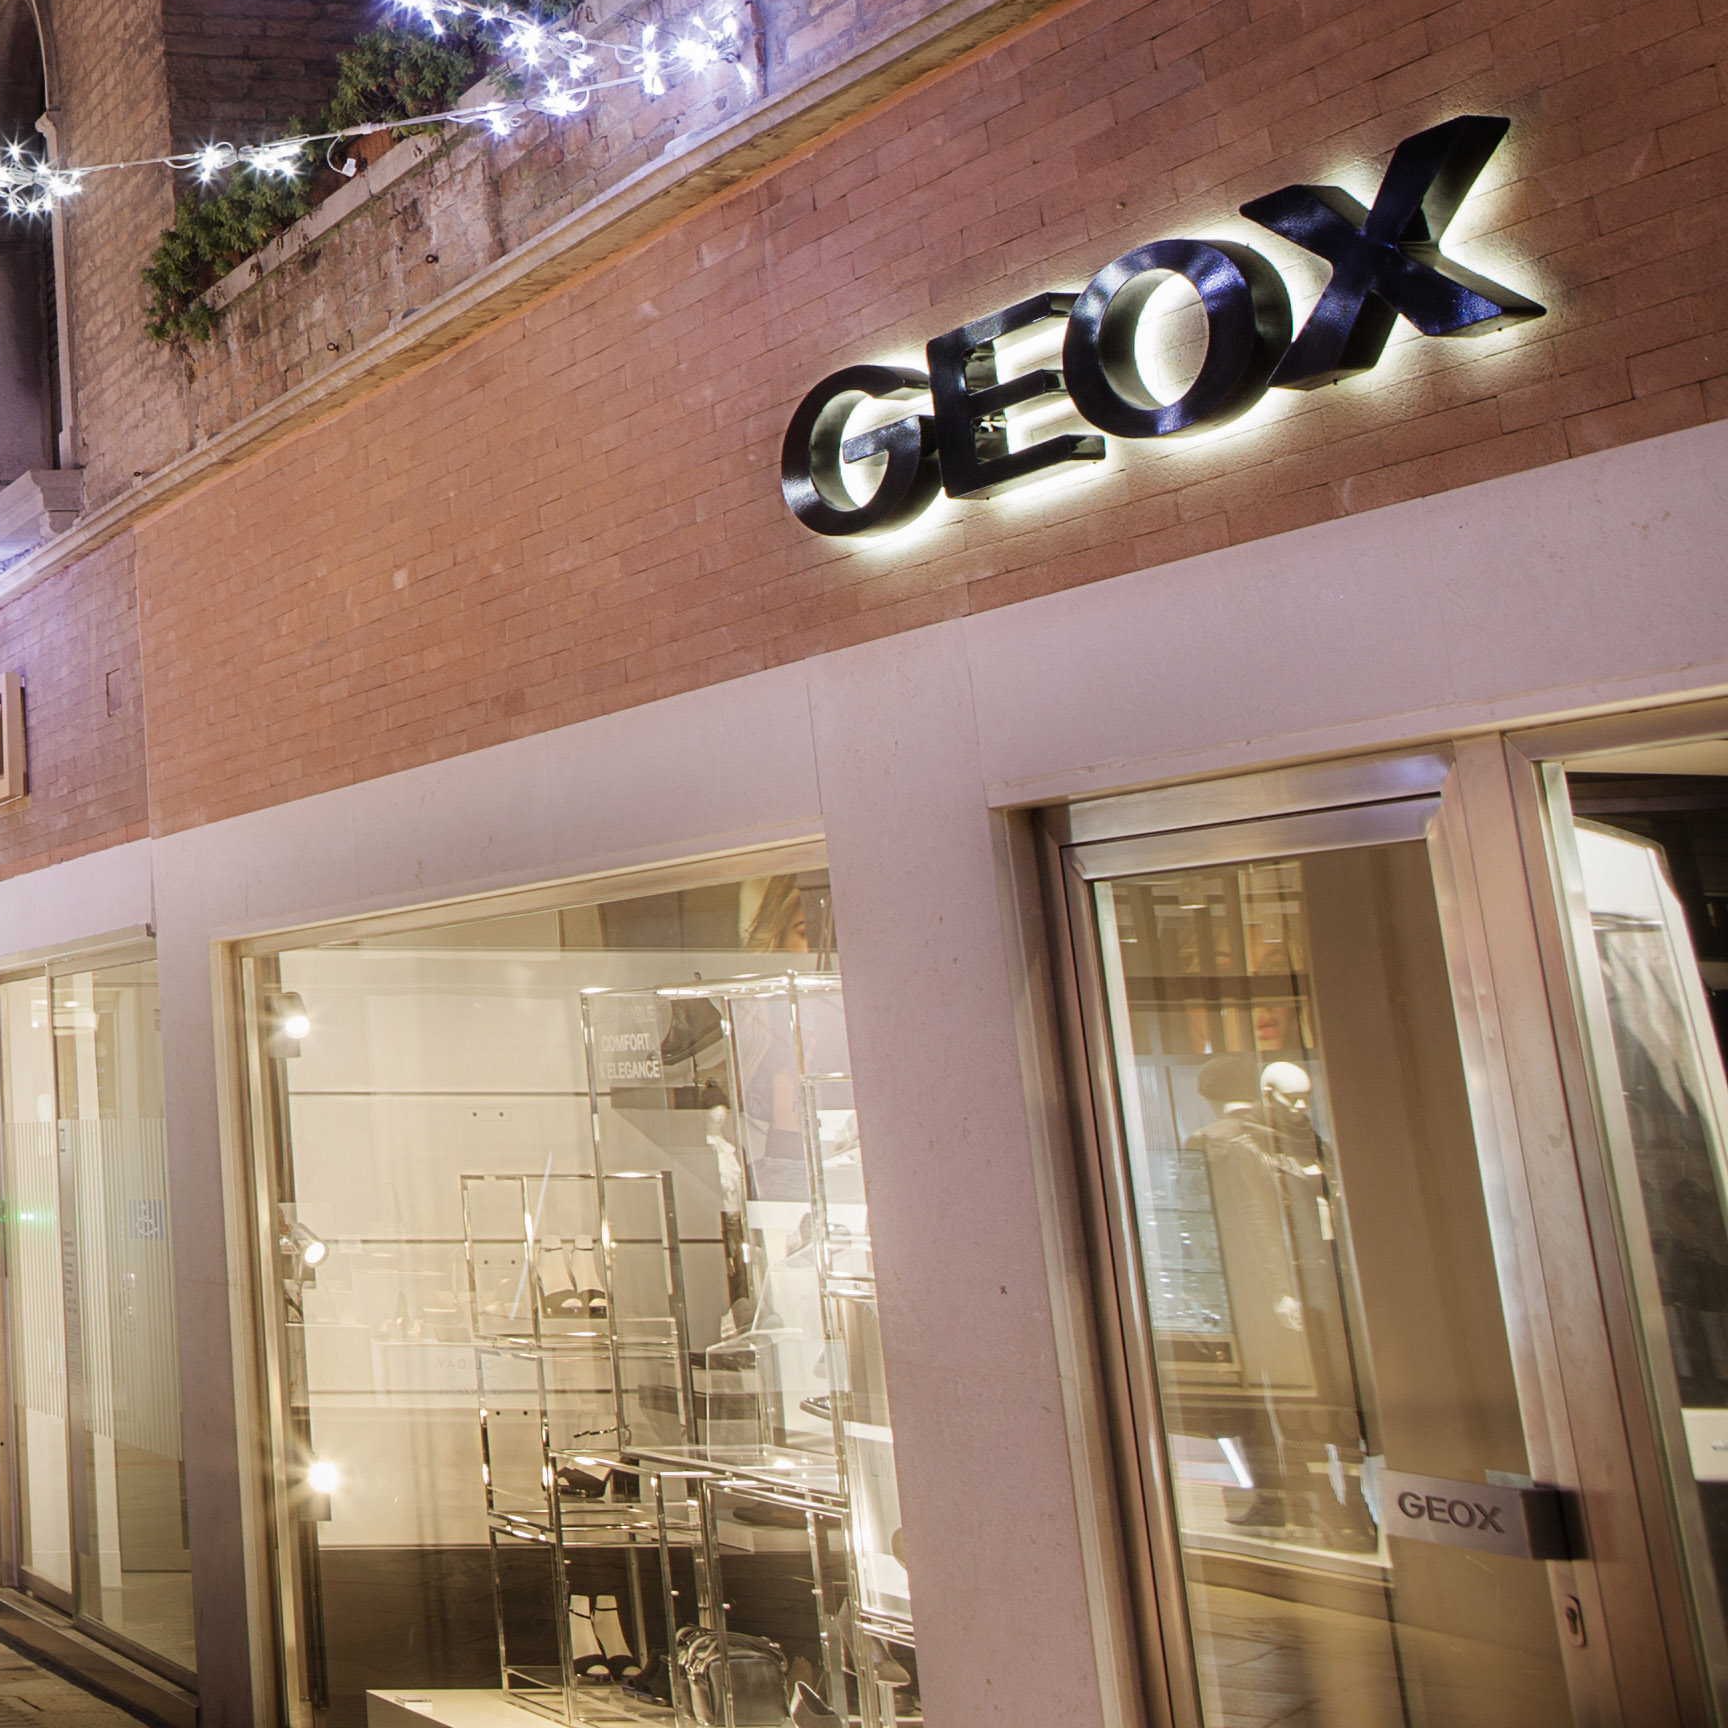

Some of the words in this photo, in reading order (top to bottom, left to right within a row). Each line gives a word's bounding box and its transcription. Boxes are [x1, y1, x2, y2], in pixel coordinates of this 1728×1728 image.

[781, 115, 1547, 537] GEOX
[600, 1032, 650, 1052] COMFORT
[607, 1060, 661, 1079] ELEGANCE
[1398, 1491, 1506, 1534] GEOX
